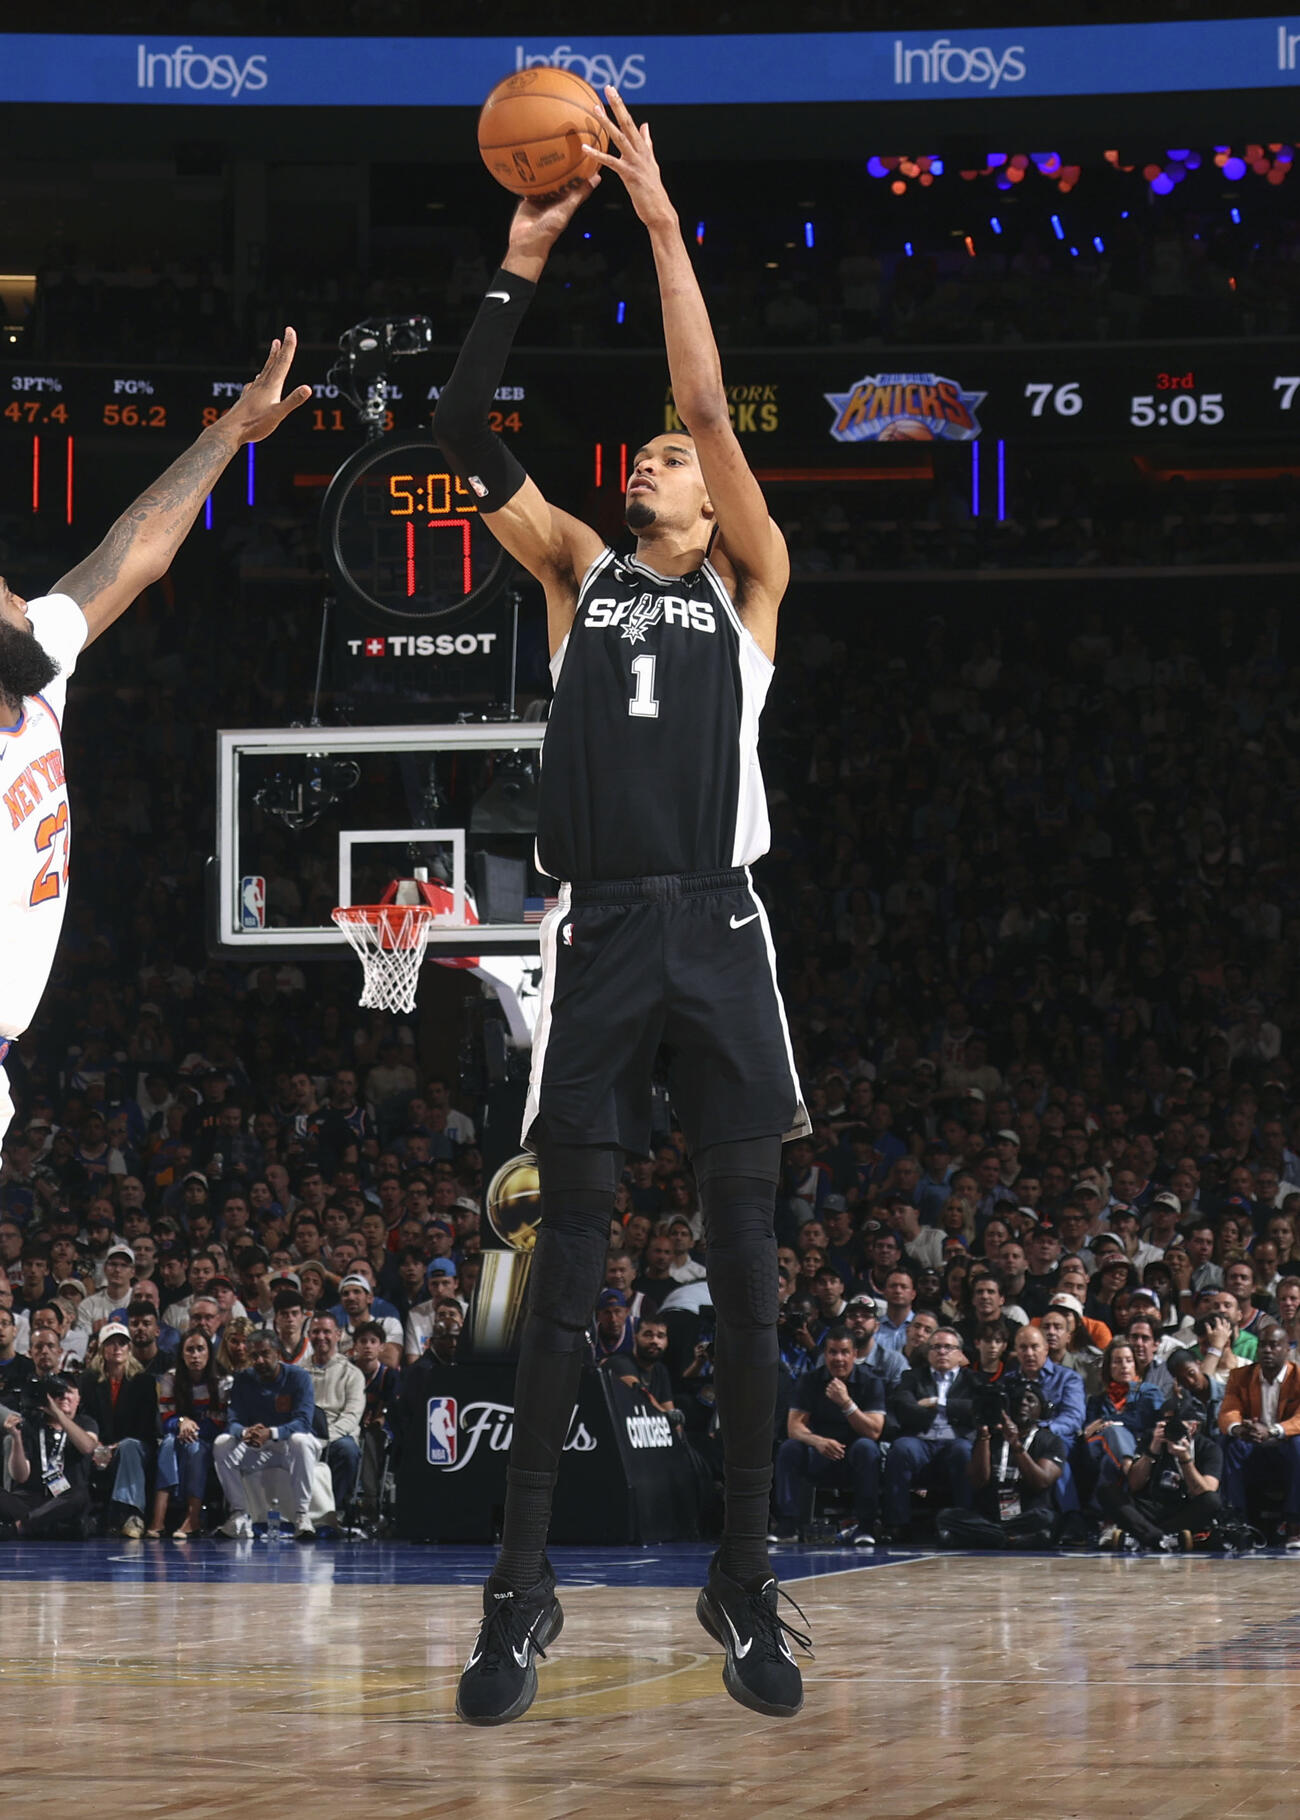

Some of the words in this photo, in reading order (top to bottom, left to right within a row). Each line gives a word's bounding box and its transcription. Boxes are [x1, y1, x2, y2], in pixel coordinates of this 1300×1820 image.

[137, 43, 268, 98] Infosys
[894, 38, 1027, 90] Infosys
[11, 376, 62, 392] 3PT%
[113, 379, 154, 395] FG%
[313, 384, 339, 398] TO
[725, 384, 778, 401] ORK
[1024, 382, 1084, 417] 76
[1156, 372, 1196, 390] 3rd
[4, 401, 69, 424] 47.4
[103, 404, 167, 427] 56.2
[312, 409, 345, 430] 11
[488, 411, 524, 432] 24
[664, 403, 779, 432] KKS
[837, 382, 974, 432] KNICKS
[1130, 393, 1225, 428] 5:05
[405, 518, 472, 597] 17
[584, 593, 717, 640] SPURS
[347, 640, 362, 655] T
[387, 633, 497, 657] TISSOT
[628, 654, 660, 718] 1
[2, 765, 43, 831] NEW
[441, 1401, 597, 1472] Fils
[626, 1404, 673, 1449] coinbase
